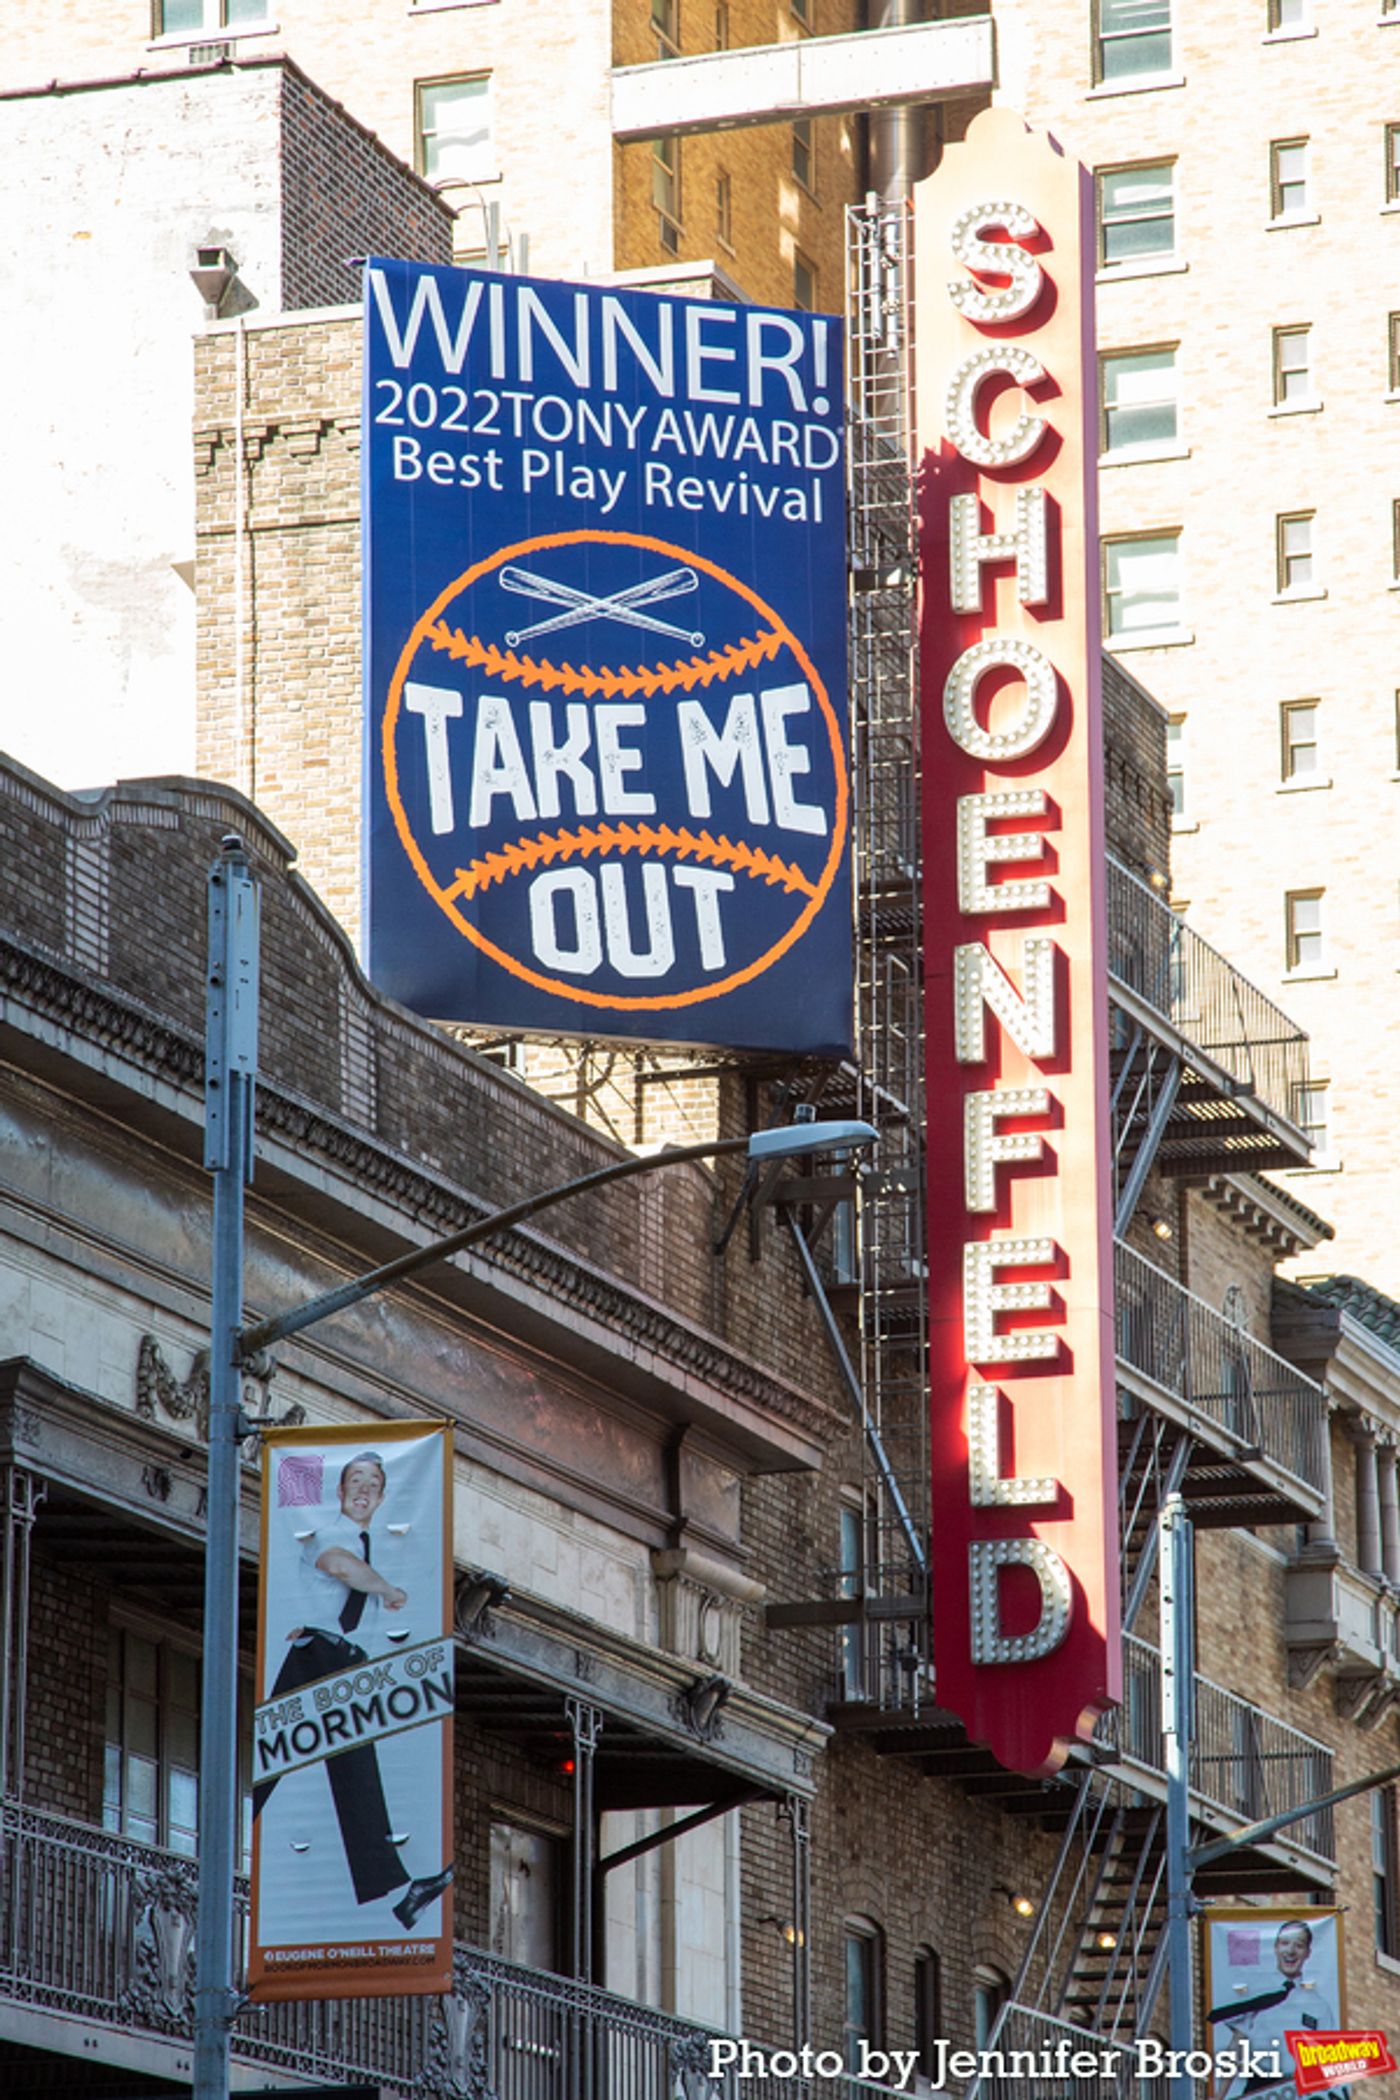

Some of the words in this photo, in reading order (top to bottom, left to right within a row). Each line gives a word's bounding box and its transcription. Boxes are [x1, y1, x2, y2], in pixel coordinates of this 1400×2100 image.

[370, 269, 830, 416] WINNER!
[393, 437, 503, 490] Best
[523, 450, 626, 513] Play
[645, 462, 823, 523] Revival
[404, 682, 656, 835] TAKE
[677, 683, 828, 836] ME
[529, 862, 736, 978] OUT
[943, 202, 1074, 1666] SCHOENFELD
[255, 1697, 304, 1735] THE
[313, 1662, 397, 1711] BOOK
[404, 1645, 445, 1678] OF
[257, 1671, 454, 1770] MORMON
[276, 1947, 324, 1962] EUGENE
[379, 1943, 436, 1957] THEATRE
